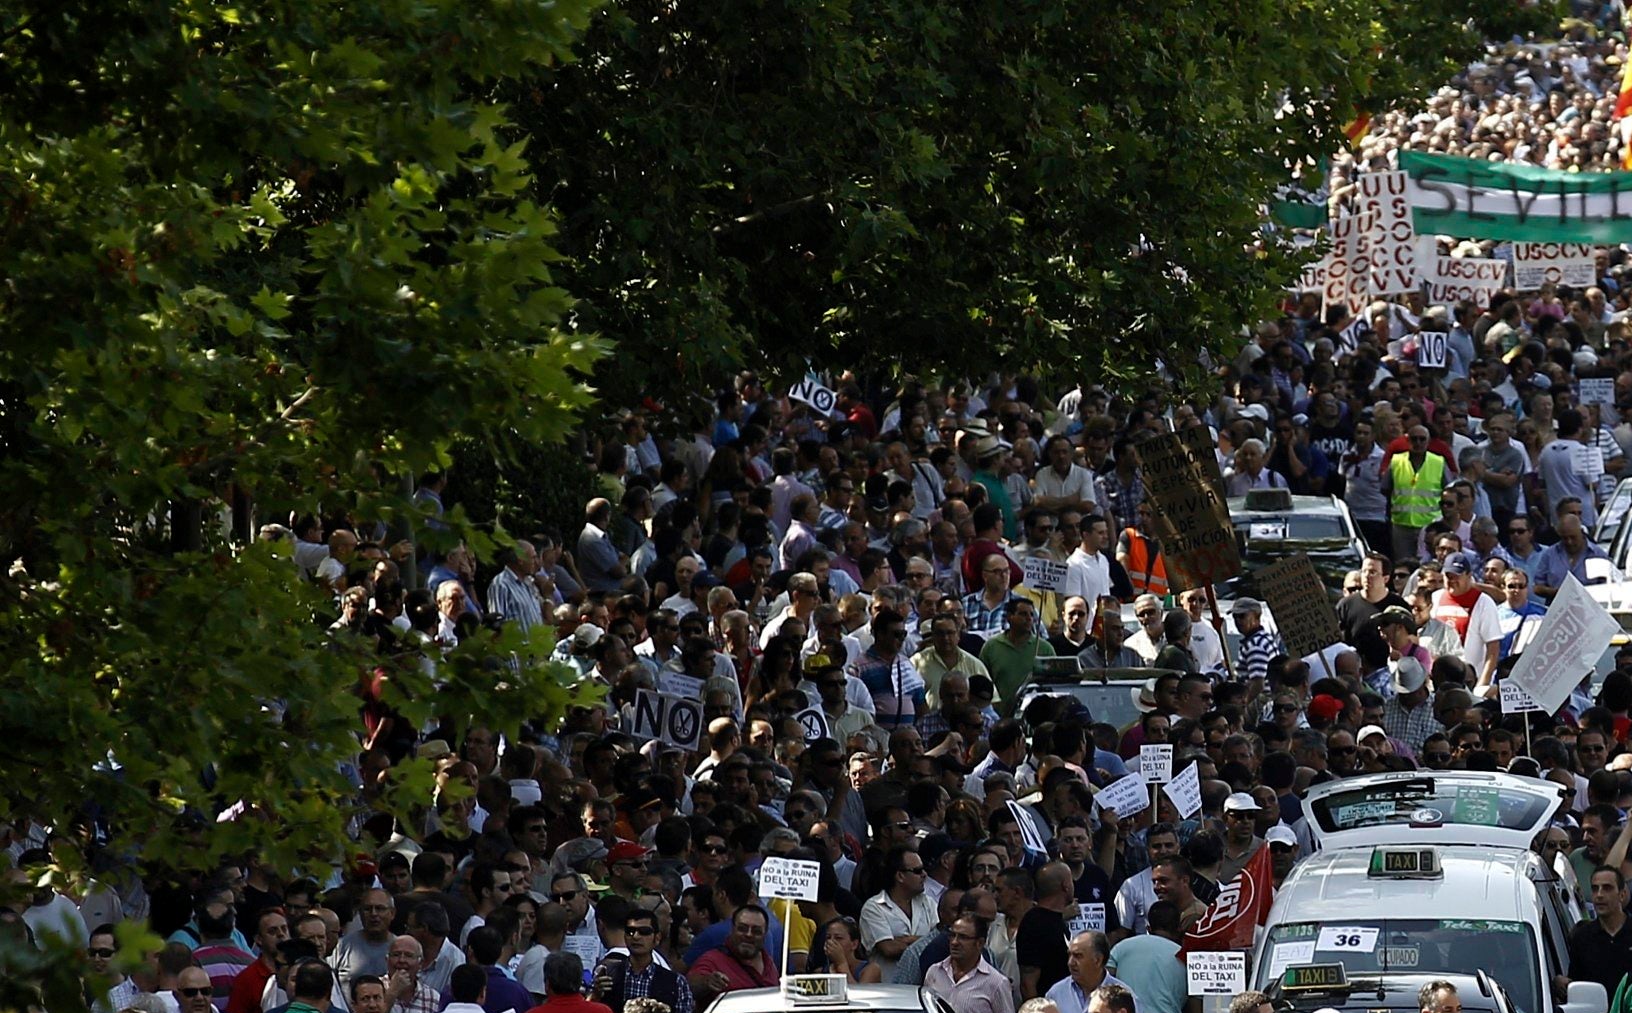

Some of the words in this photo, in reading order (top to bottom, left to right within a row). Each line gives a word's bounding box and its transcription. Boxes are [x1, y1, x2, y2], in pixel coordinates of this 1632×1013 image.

[1437, 259, 1504, 280] USOCV
[1421, 334, 1444, 365] NO
[793, 381, 834, 411] NO
[634, 690, 701, 746] NO
[1384, 851, 1417, 870] TAXI
[763, 866, 775, 874] NO
[790, 868, 818, 879] RUINA
[764, 875, 784, 885] DEL
[787, 876, 809, 887] TAXI
[1083, 921, 1100, 930] TAXI
[1333, 935, 1362, 948] 36
[1189, 962, 1202, 971] NO
[1218, 962, 1244, 971] RUINA
[1191, 972, 1211, 981] DEL
[1215, 972, 1236, 981] TAXI
[1297, 969, 1326, 985] TAXI
[798, 978, 829, 995] TAXI
